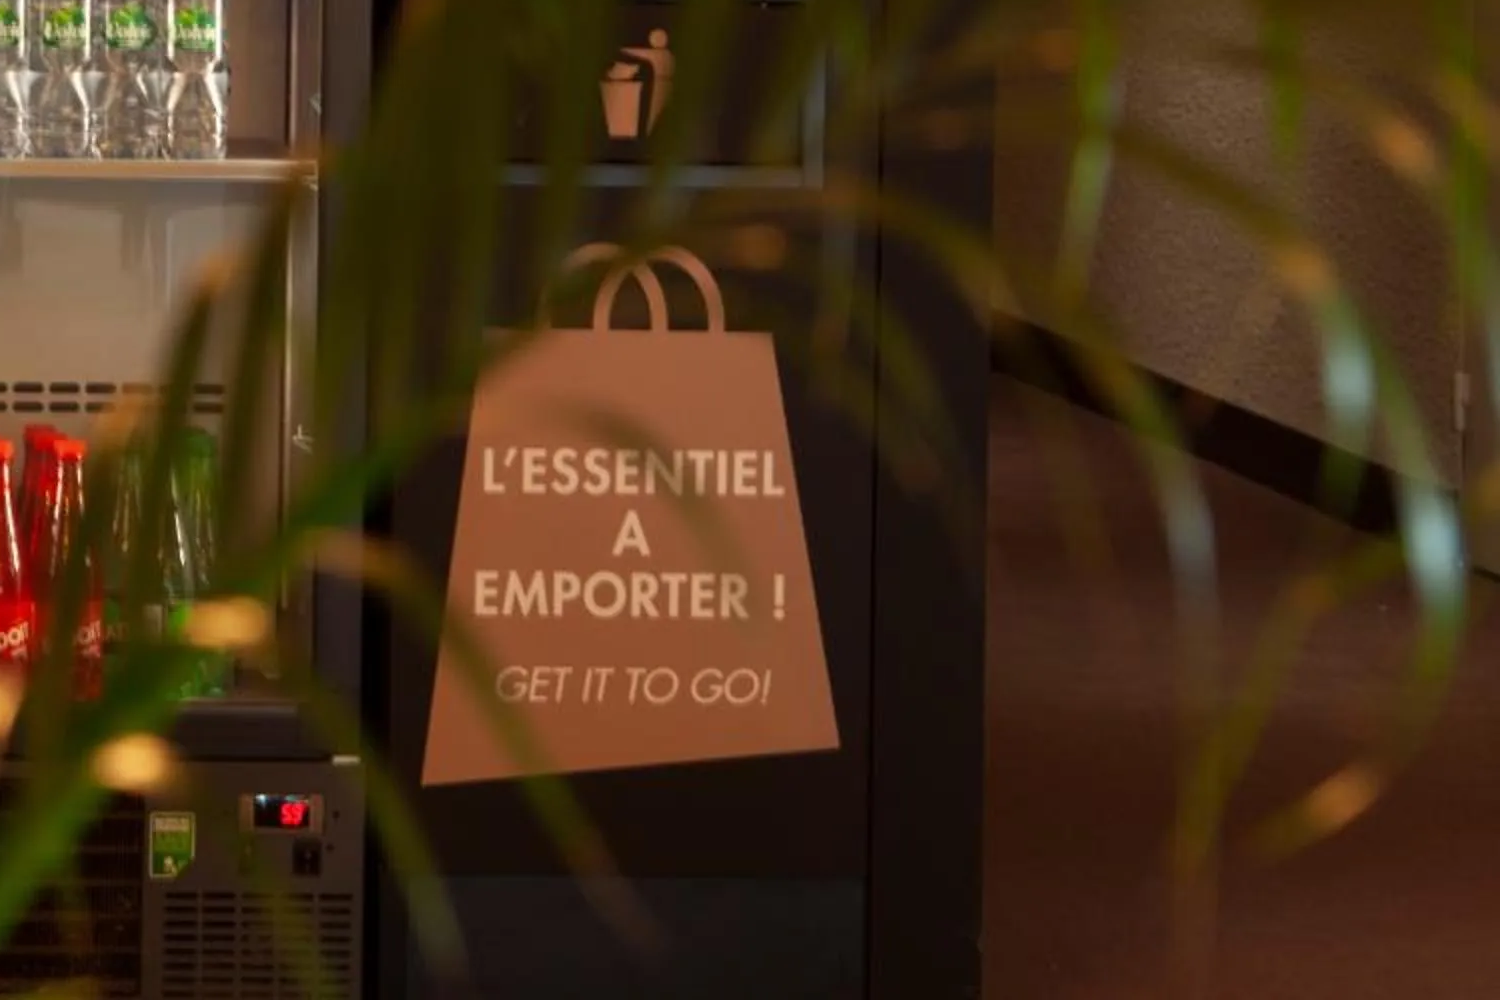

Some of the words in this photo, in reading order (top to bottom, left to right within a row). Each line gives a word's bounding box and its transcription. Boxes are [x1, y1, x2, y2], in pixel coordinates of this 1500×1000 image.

[483, 447, 786, 496] L'ESSENTIEL
[611, 509, 651, 557] A
[473, 569, 749, 619] EMPORTER
[772, 573, 786, 622] !
[495, 665, 574, 704] GET
[581, 667, 615, 704] IT
[625, 667, 680, 705] TO
[690, 667, 773, 705] GO!
